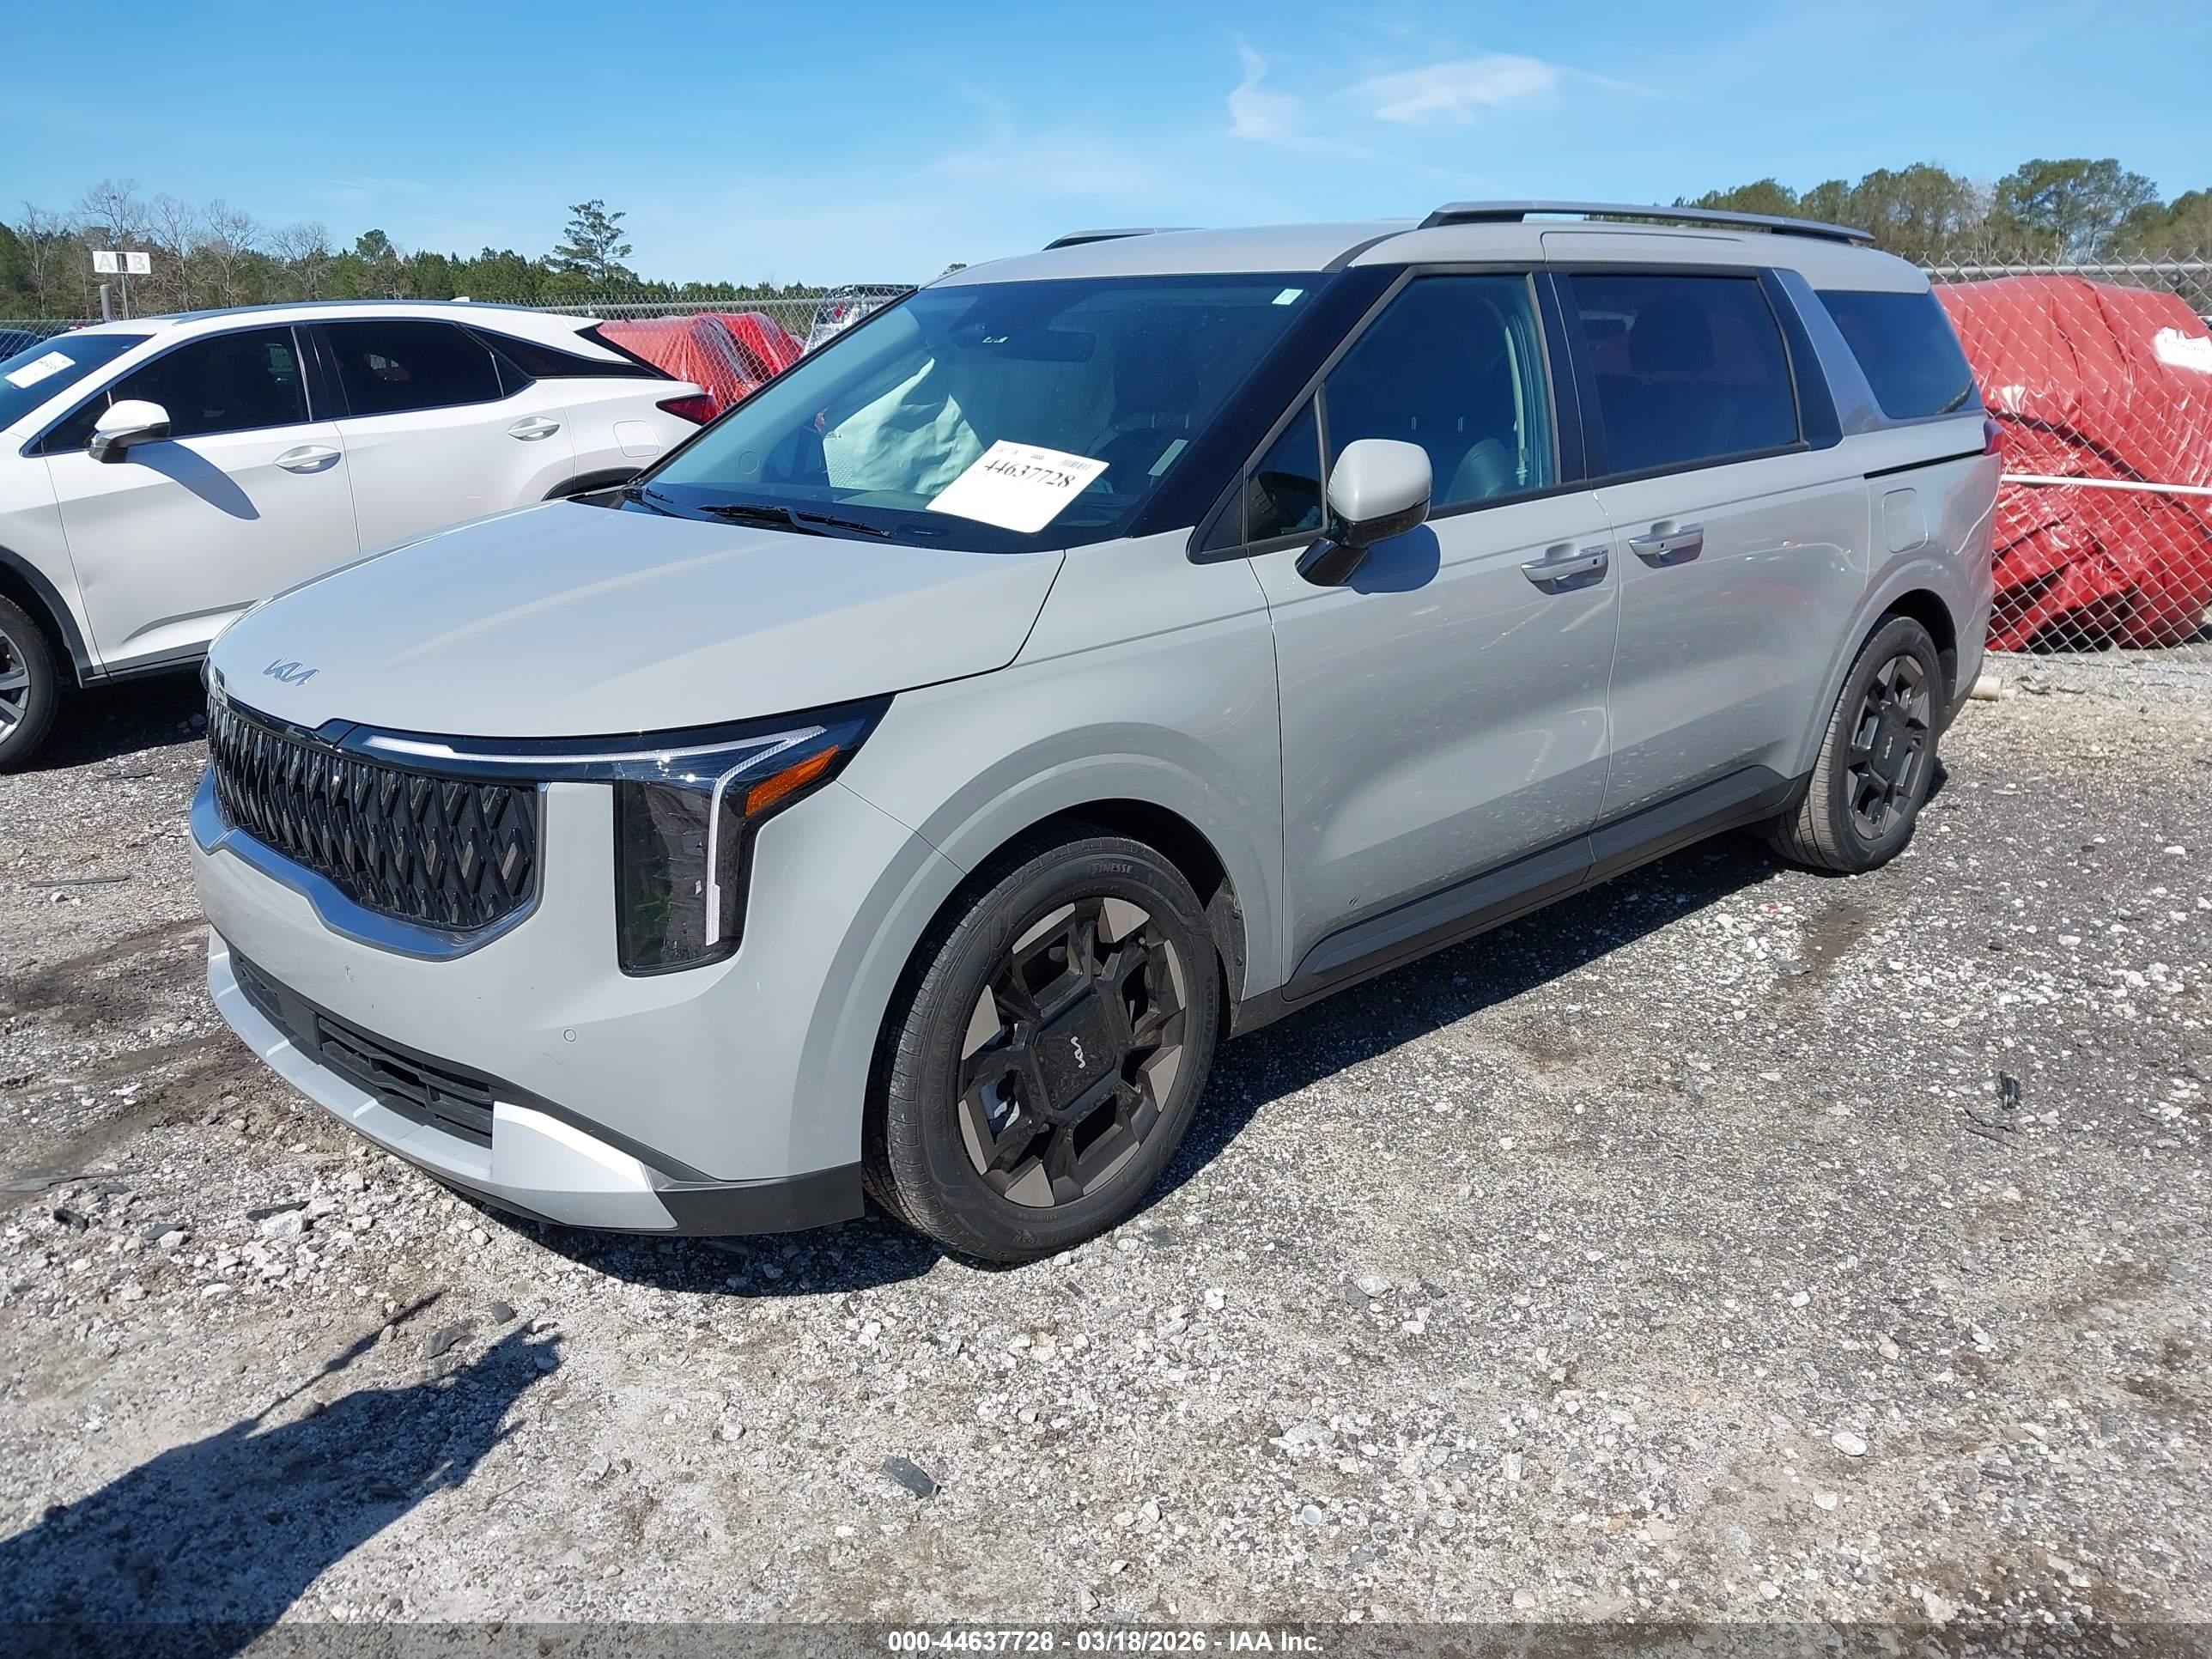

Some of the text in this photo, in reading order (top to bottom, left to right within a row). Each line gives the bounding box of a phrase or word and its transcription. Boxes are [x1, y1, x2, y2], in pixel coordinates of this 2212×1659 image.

[98, 254, 146, 271] A B
[984, 459, 1076, 489] 44637728
